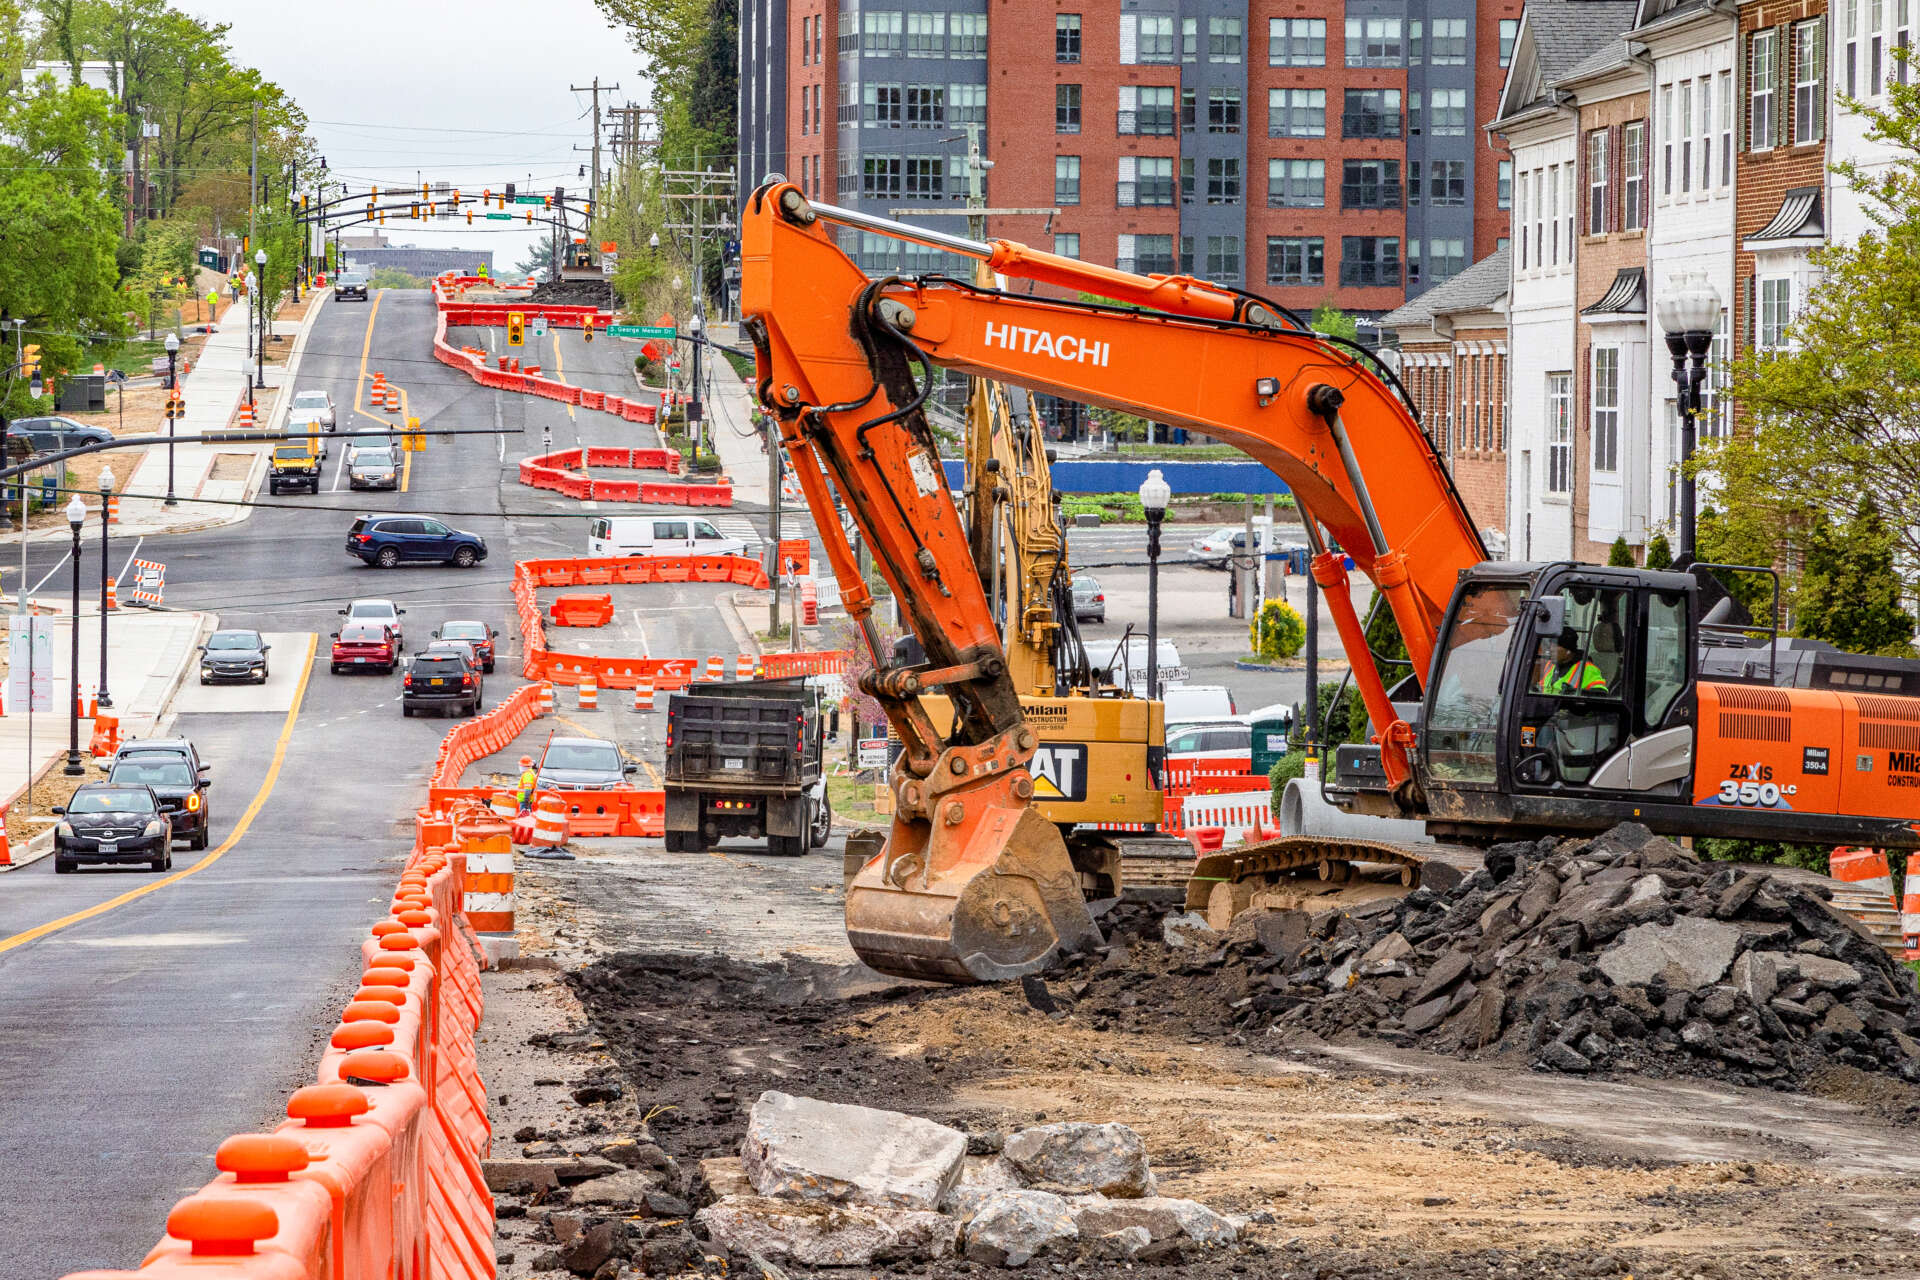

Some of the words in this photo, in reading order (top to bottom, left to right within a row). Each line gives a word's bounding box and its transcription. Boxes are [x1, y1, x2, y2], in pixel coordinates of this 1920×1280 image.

[984, 321, 1110, 367] HITACHI
[1136, 667, 1180, 681] Raolph
[1022, 705, 1067, 716] Milani
[1806, 749, 1827, 757] Milani
[1730, 762, 1773, 780] ZAXIS
[1805, 761, 1826, 770] 350-A
[1029, 748, 1080, 798] AT
[1718, 780, 1779, 807] 350
[1780, 784, 1797, 795] LC
[1905, 936, 1917, 949] NI
